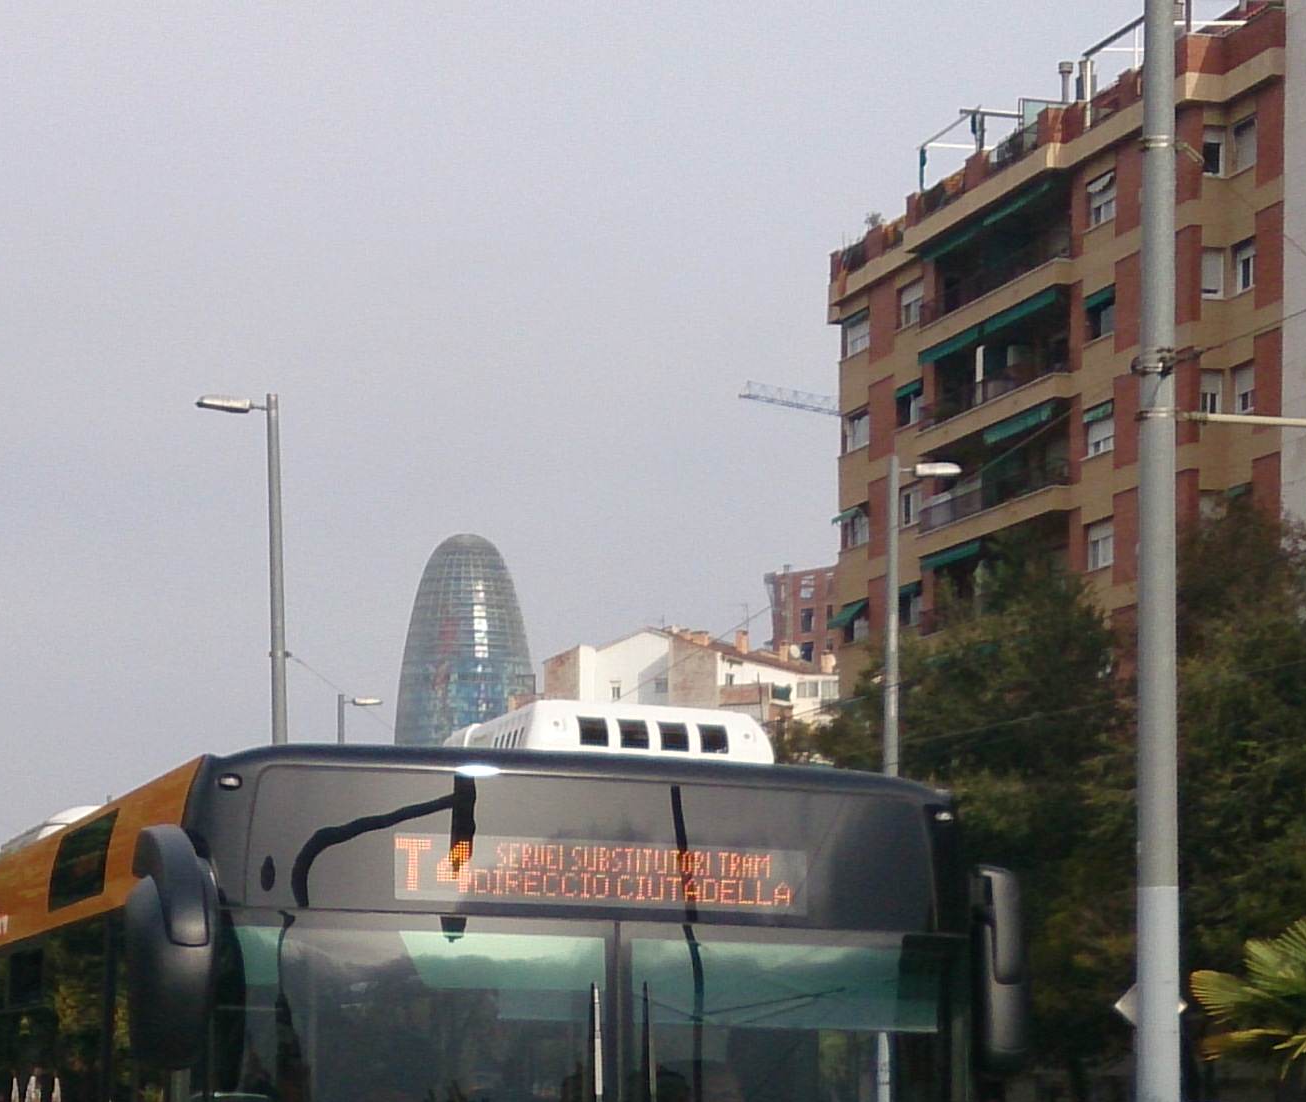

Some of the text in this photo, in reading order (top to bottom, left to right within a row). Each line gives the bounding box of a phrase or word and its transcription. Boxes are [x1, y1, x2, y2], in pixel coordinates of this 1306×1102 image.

[495, 842, 565, 870] SERVEI
[717, 851, 772, 878] TRAM
[616, 874, 792, 907] CIUTADELLA
